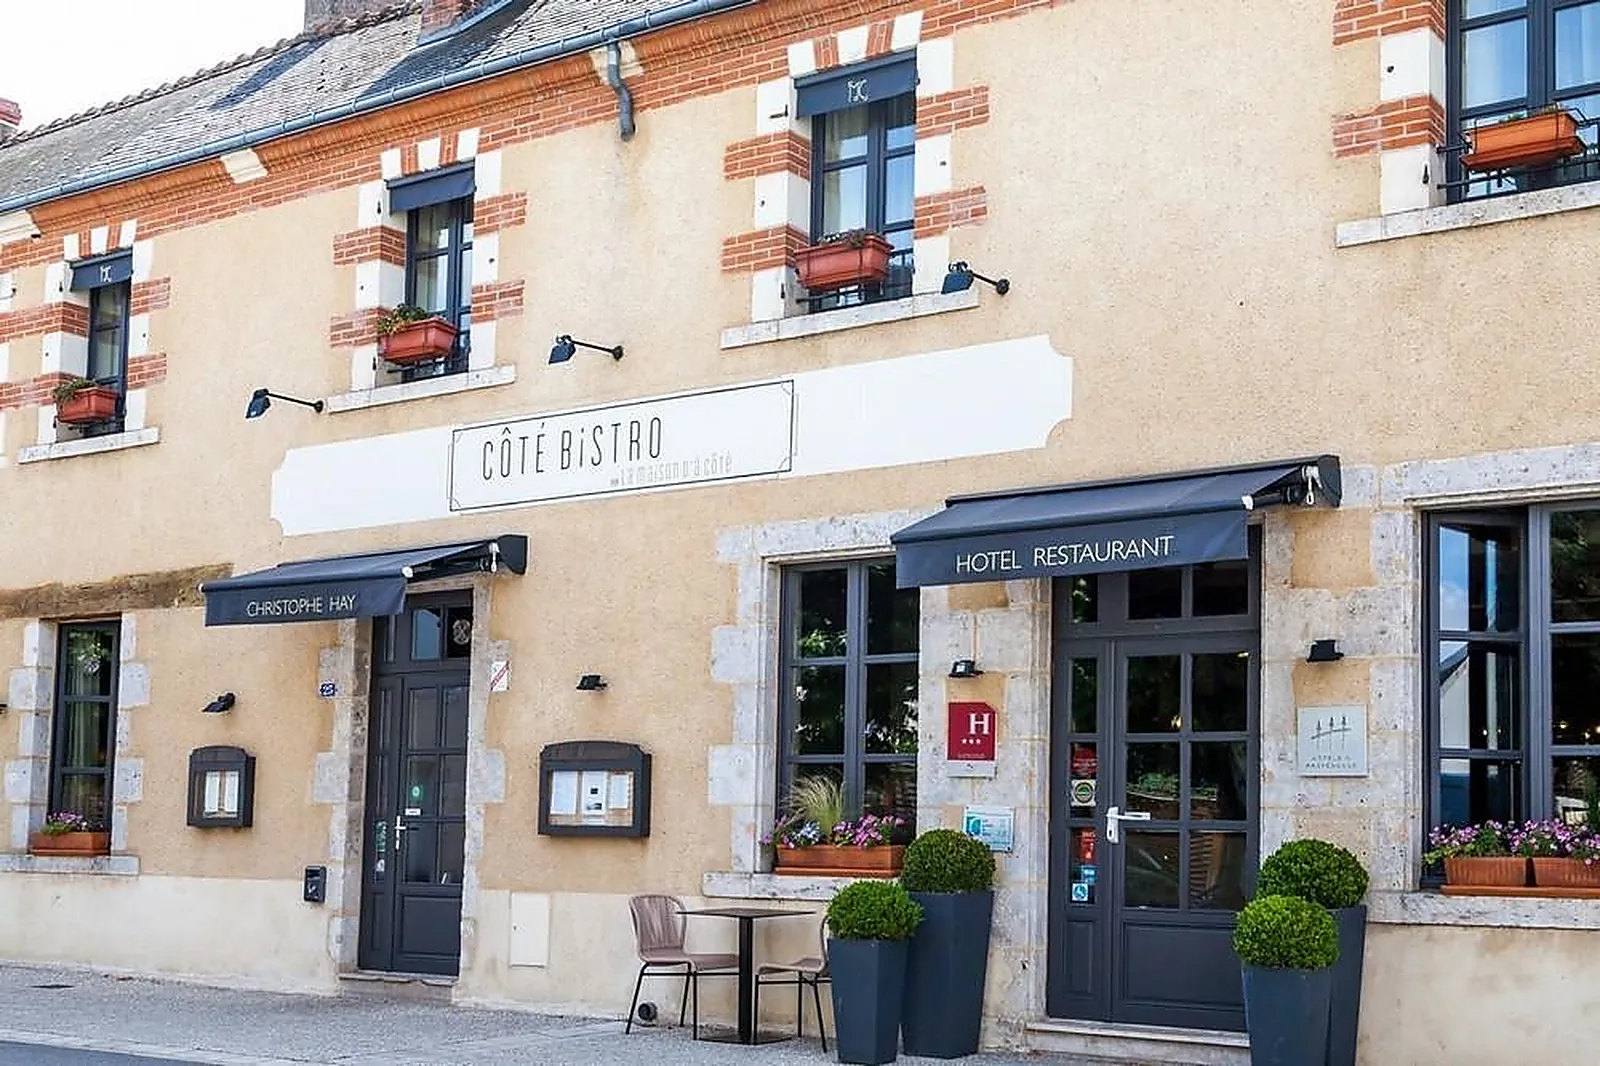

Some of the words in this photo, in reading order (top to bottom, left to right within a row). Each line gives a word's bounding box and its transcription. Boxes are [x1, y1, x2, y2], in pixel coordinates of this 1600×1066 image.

[482, 422, 546, 481] CÔTÉ
[956, 550, 1022, 574] HOTEL
[1034, 535, 1175, 567] RESTAURANT
[246, 597, 323, 617] CHRISTOPHE
[329, 594, 356, 613] HAY
[969, 713, 990, 735] H
